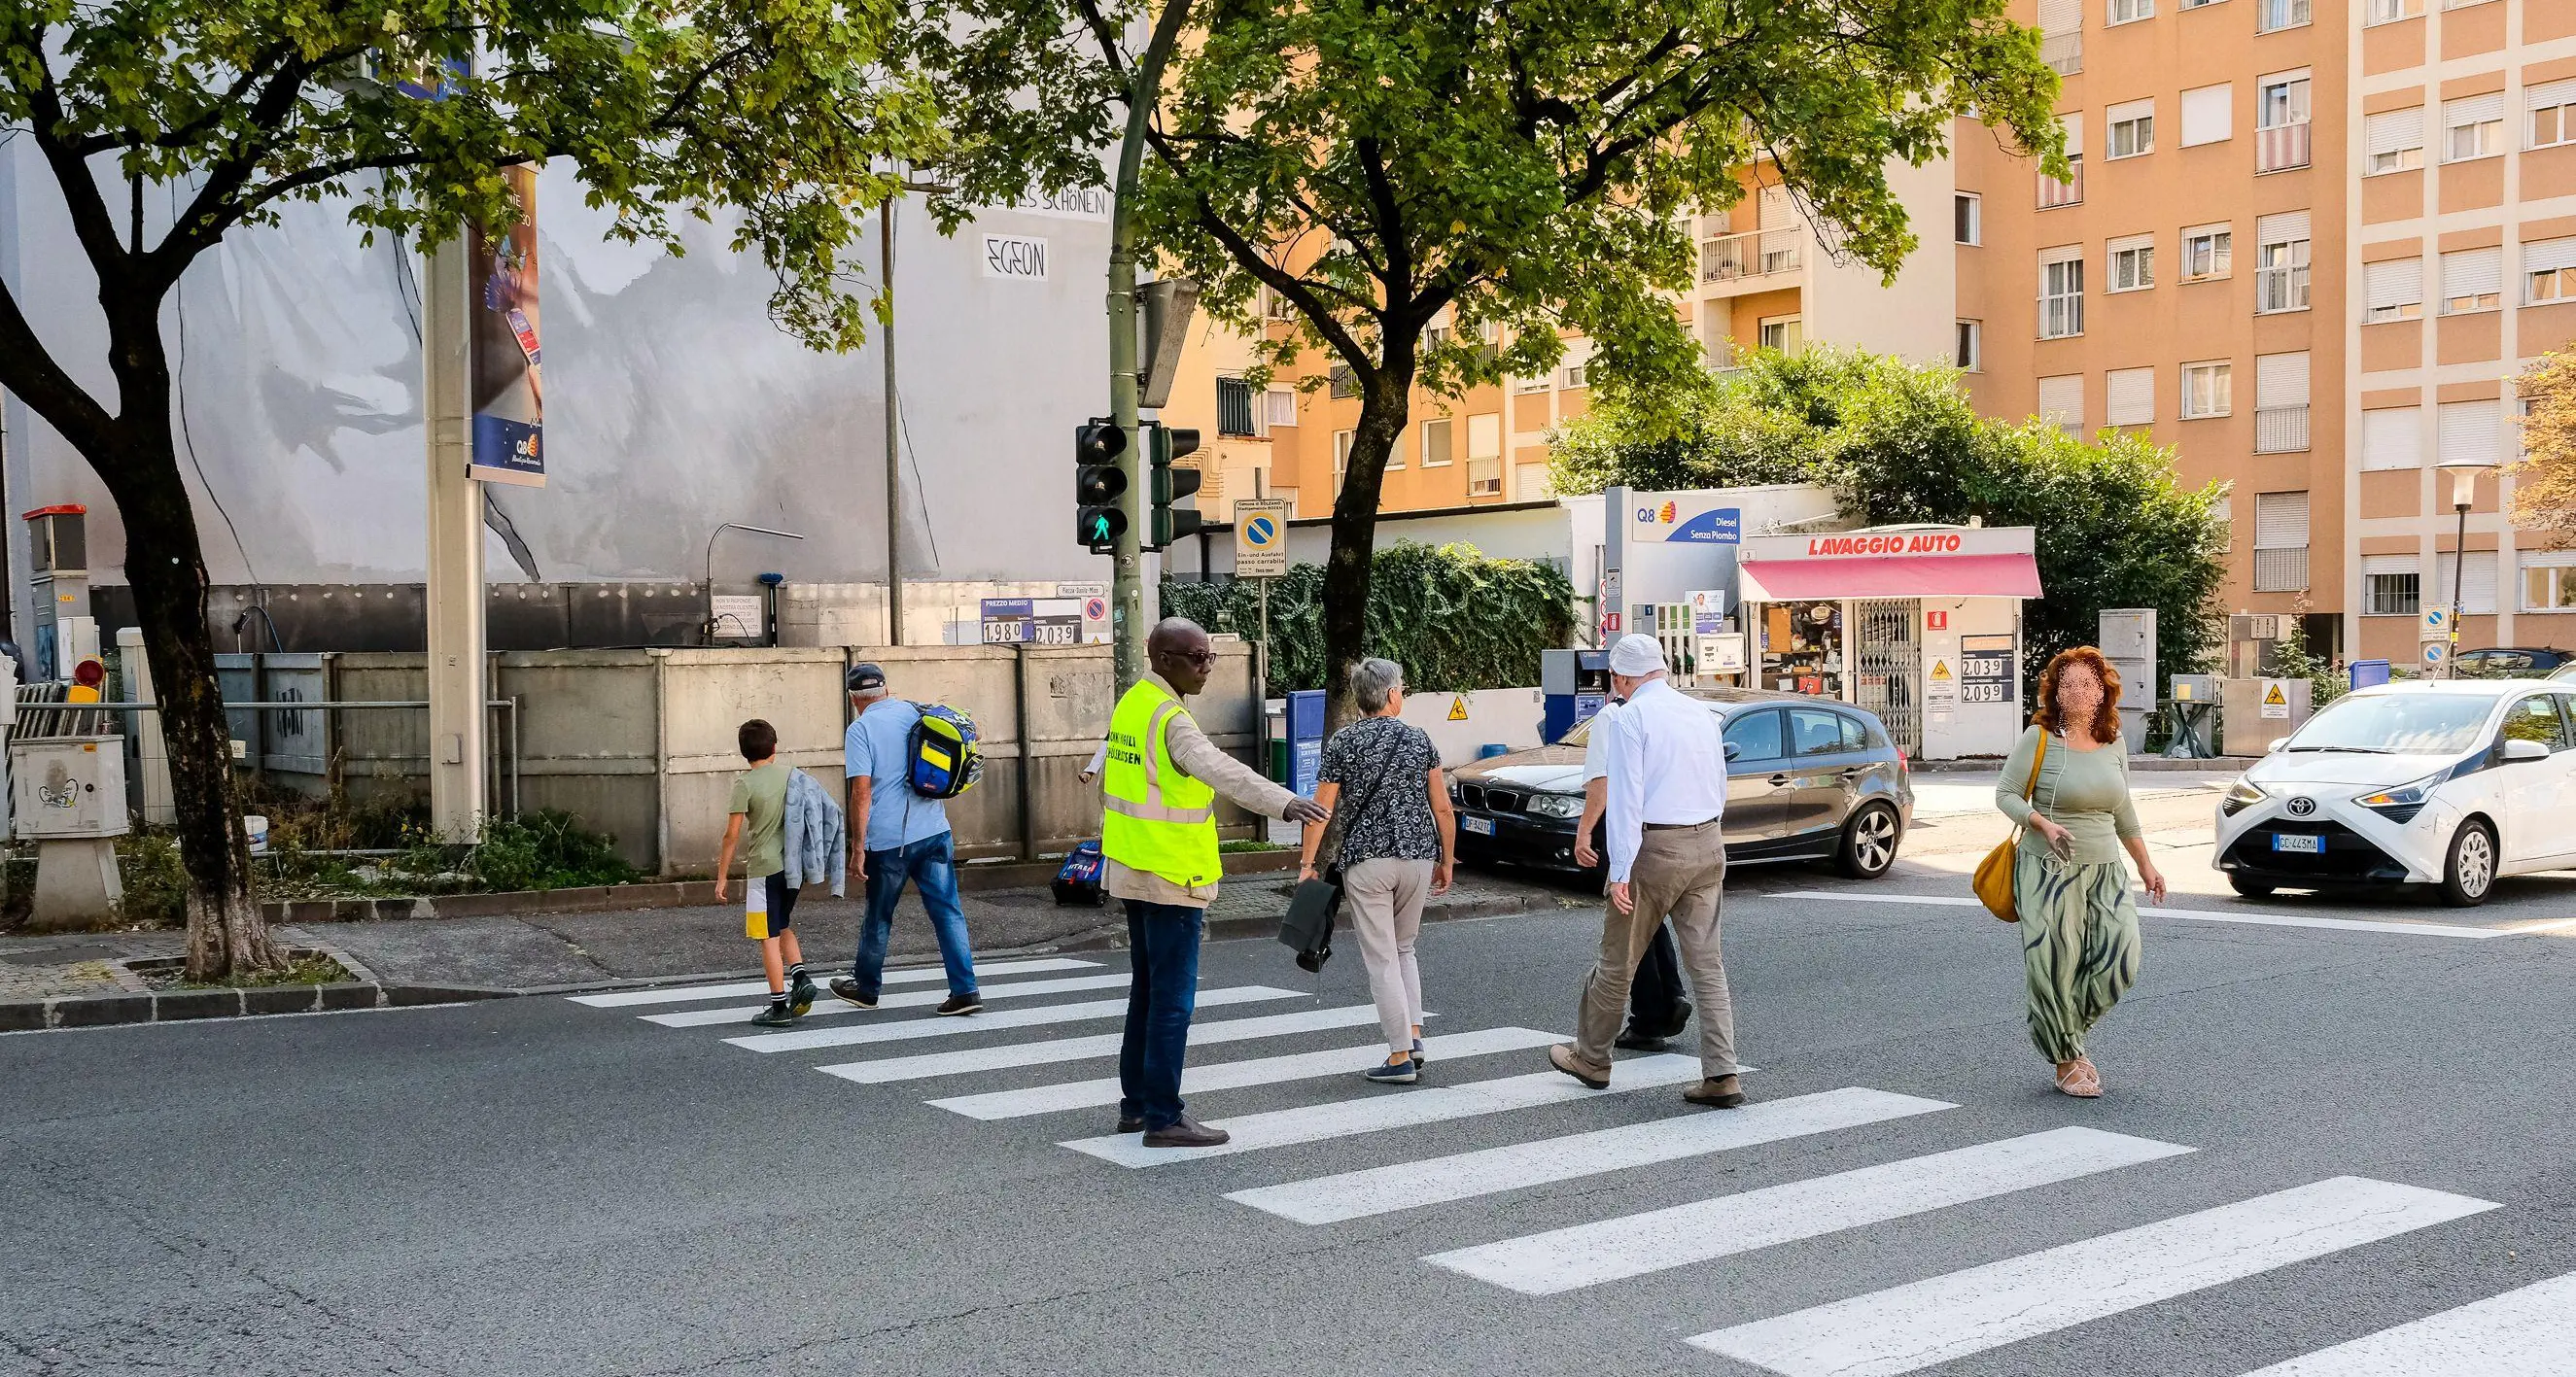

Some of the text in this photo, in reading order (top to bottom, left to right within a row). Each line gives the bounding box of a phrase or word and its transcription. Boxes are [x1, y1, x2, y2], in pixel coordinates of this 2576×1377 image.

[1043, 189, 1105, 215] SCHÖNEN
[988, 239, 1044, 276] EGEON
[1637, 508, 1655, 523] Q8
[1716, 517, 1737, 528] Diesel
[1690, 530, 1737, 540] Senza Piombo
[1808, 534, 1962, 556] LAVAGGIO AUTO
[985, 623, 1021, 641] 1,980
[1036, 627, 1072, 644] 2,039
[1963, 660, 2001, 675] 2,039
[1964, 685, 2001, 702] 2,099
